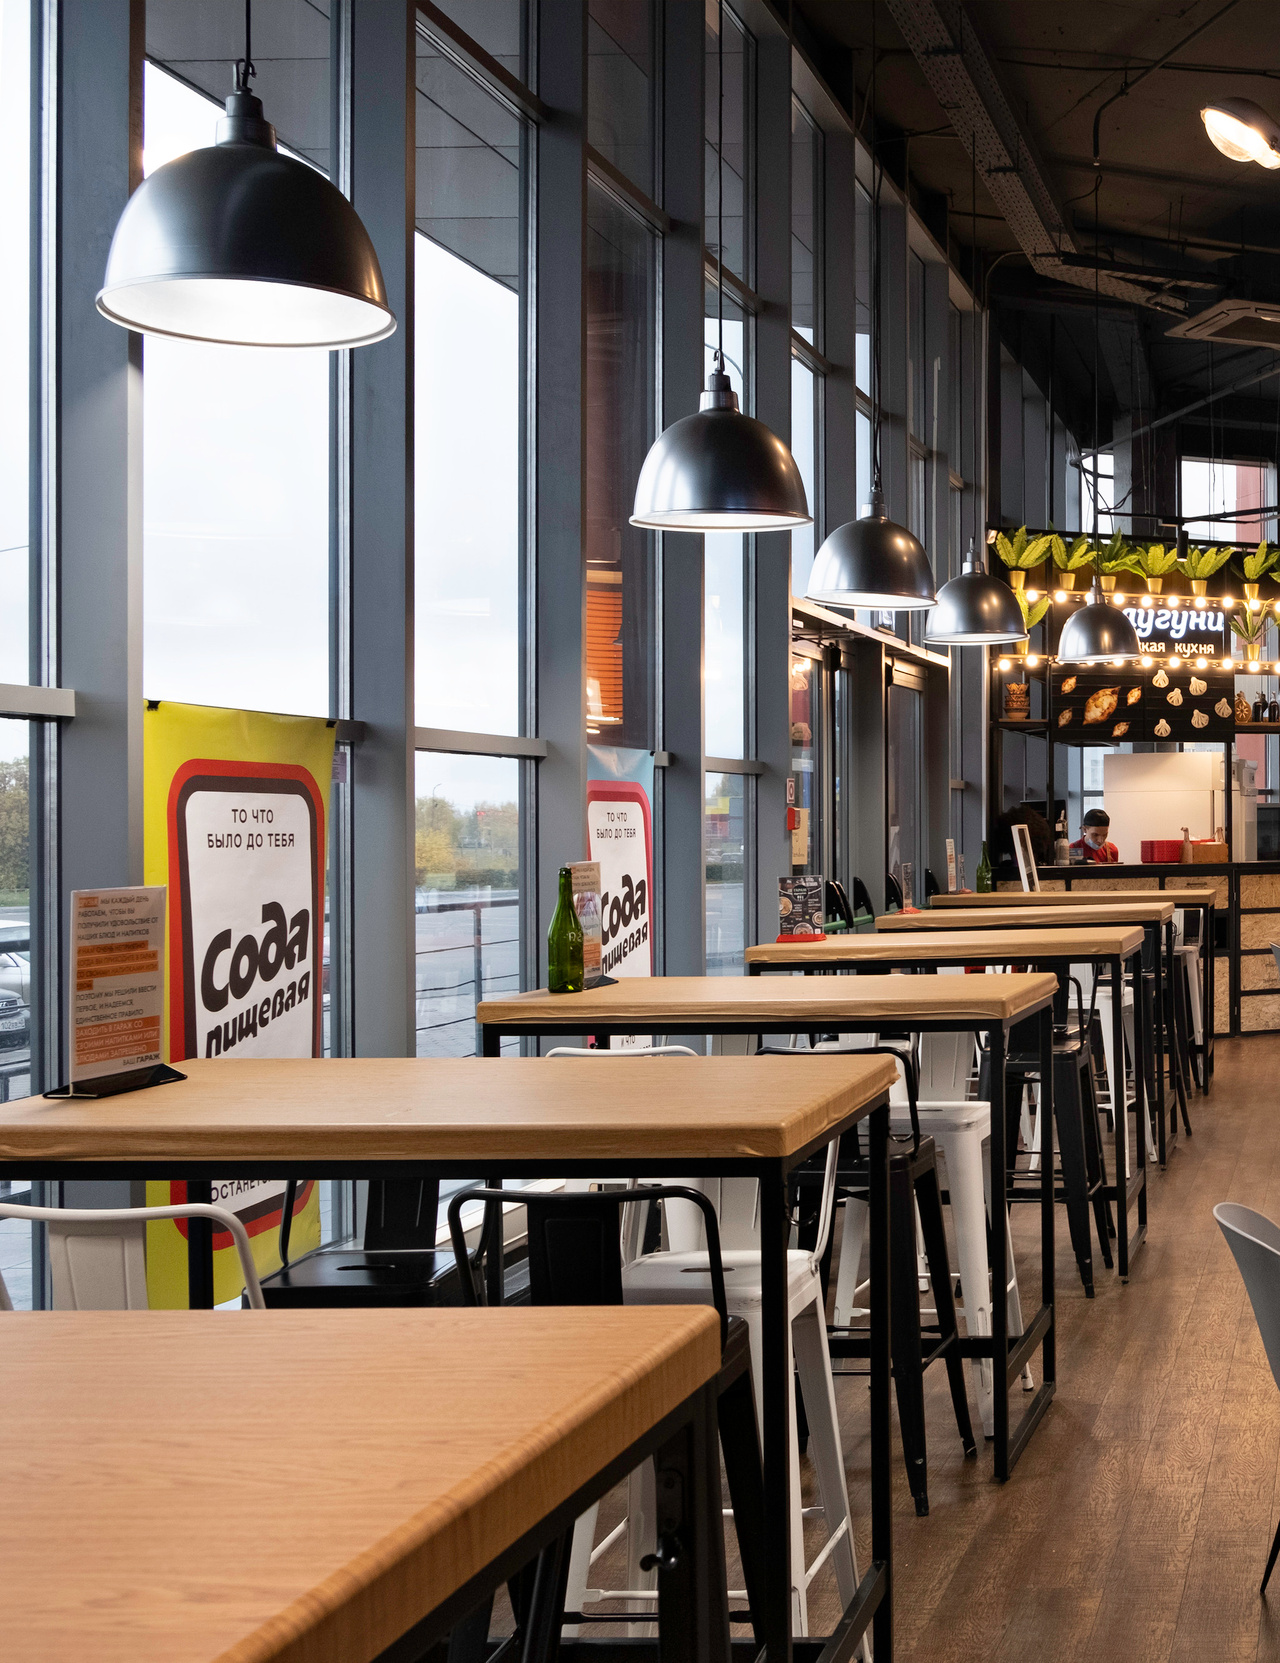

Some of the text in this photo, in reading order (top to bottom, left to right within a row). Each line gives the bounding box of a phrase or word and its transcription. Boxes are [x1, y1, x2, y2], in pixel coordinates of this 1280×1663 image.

[1174, 643, 1215, 658] кухня
[231, 808, 274, 824] ТО ЧТО
[606, 812, 628, 823] ТО ЧТО
[207, 833, 295, 851] БЫЛО ДО ТЕБЯ
[596, 828, 637, 840] БЫЛО ДО ТЕБЯ
[601, 873, 647, 946] Сода
[200, 901, 310, 1013] Сода
[601, 921, 648, 975] пищевая
[205, 971, 311, 1059] пищевая
[136, 1053, 160, 1063] ГАРАЖ
[211, 1180, 272, 1203] ОСТАНЕ
